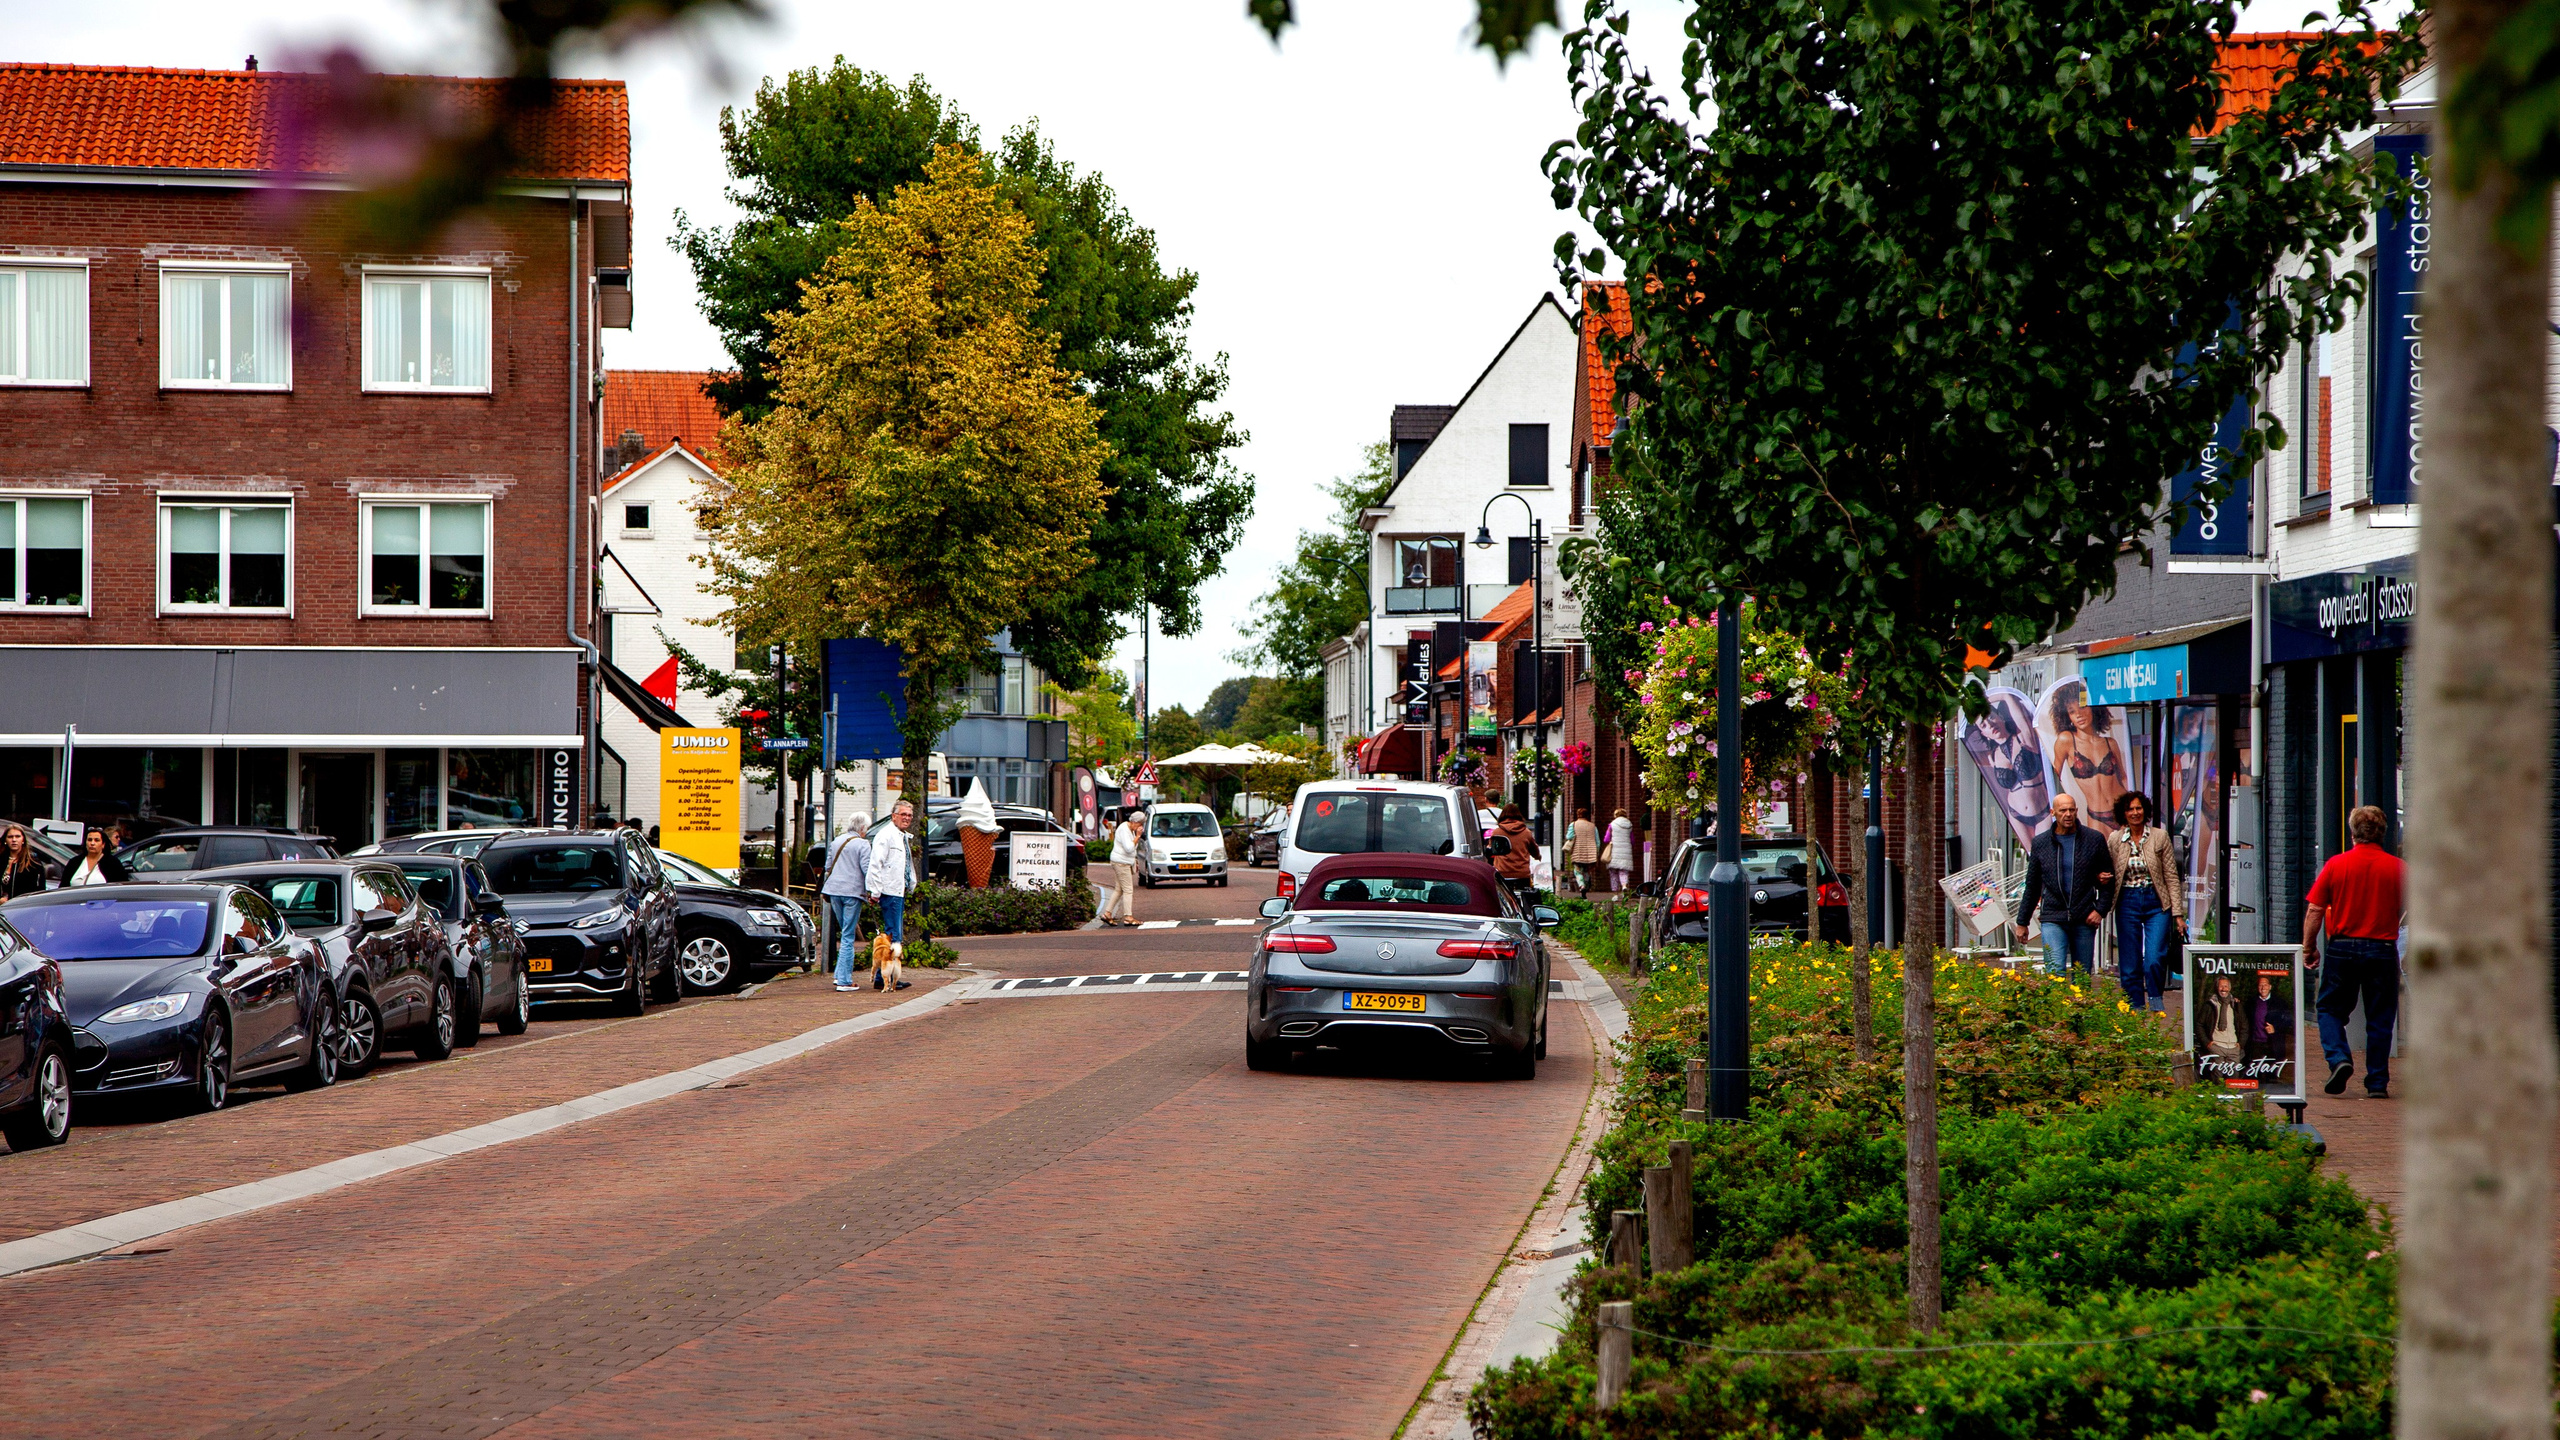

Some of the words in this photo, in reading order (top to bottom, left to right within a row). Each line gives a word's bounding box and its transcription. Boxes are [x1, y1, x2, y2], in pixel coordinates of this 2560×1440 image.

[2319, 582, 2368, 638] oogwereld
[2105, 667, 2122, 691] GSM
[671, 736, 730, 748] JUMBO
[773, 740, 808, 748] ANNAPLEIN
[2233, 962, 2290, 970] MANNENMODE
[1355, 994, 1421, 1009] XZ-909-B
[2199, 1054, 2246, 1076] Frisse
[2245, 1055, 2296, 1078] start
